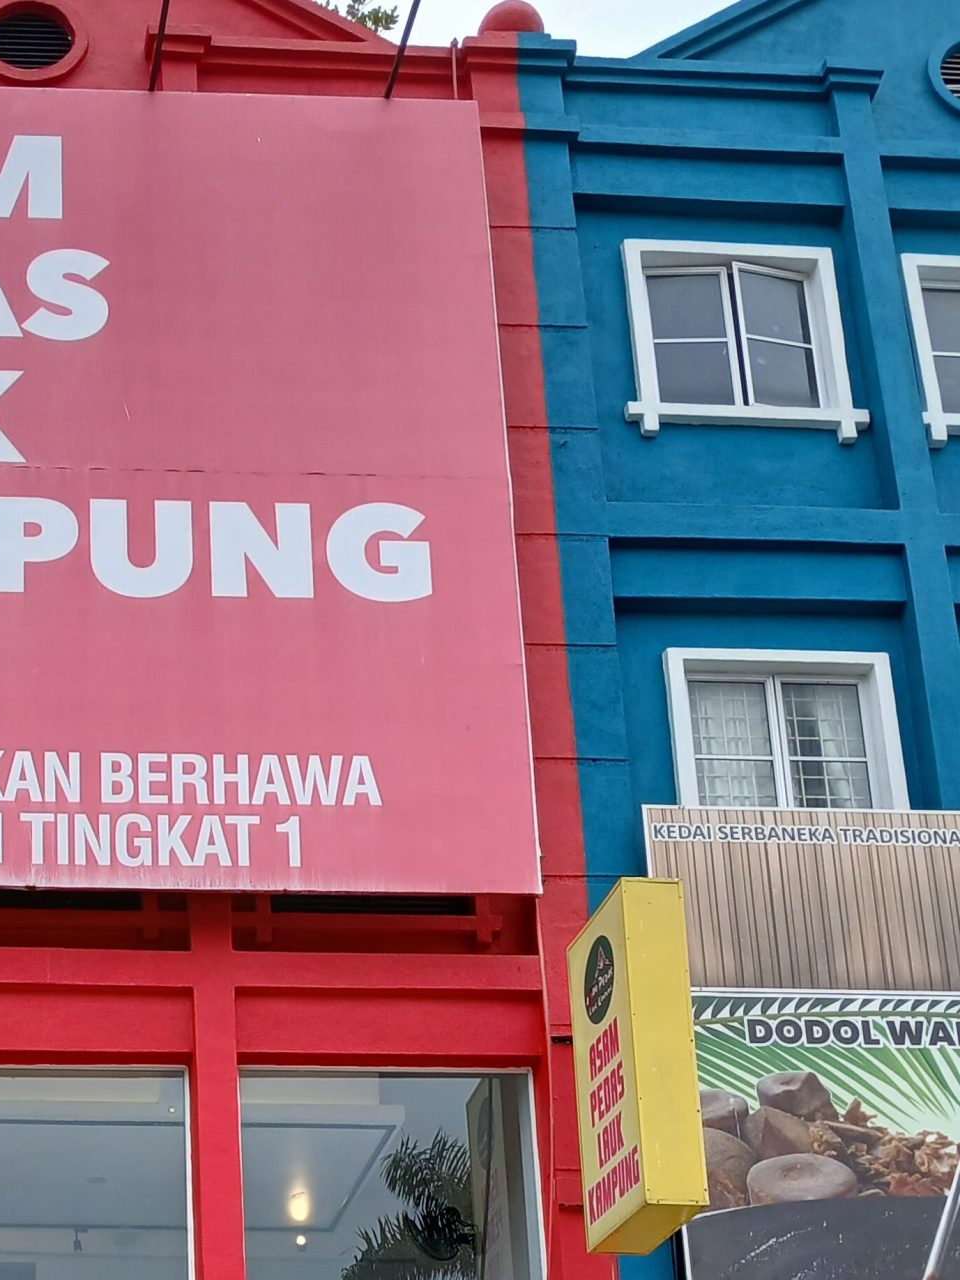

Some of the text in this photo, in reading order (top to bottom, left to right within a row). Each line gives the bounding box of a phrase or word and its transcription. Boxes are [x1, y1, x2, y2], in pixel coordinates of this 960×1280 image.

[101, 751, 383, 807] BERHAWA
[20, 812, 260, 868] TINGKAT
[275, 816, 301, 869] 1
[652, 824, 960, 846] KEDAI SERBANEKA TRADISIONA
[589, 1016, 620, 1082] ASAM
[746, 1018, 960, 1046] DODOL WA
[589, 1060, 626, 1129] PEDAS
[597, 1110, 625, 1170] LAUK
[588, 1144, 641, 1226] KAMPUNG
